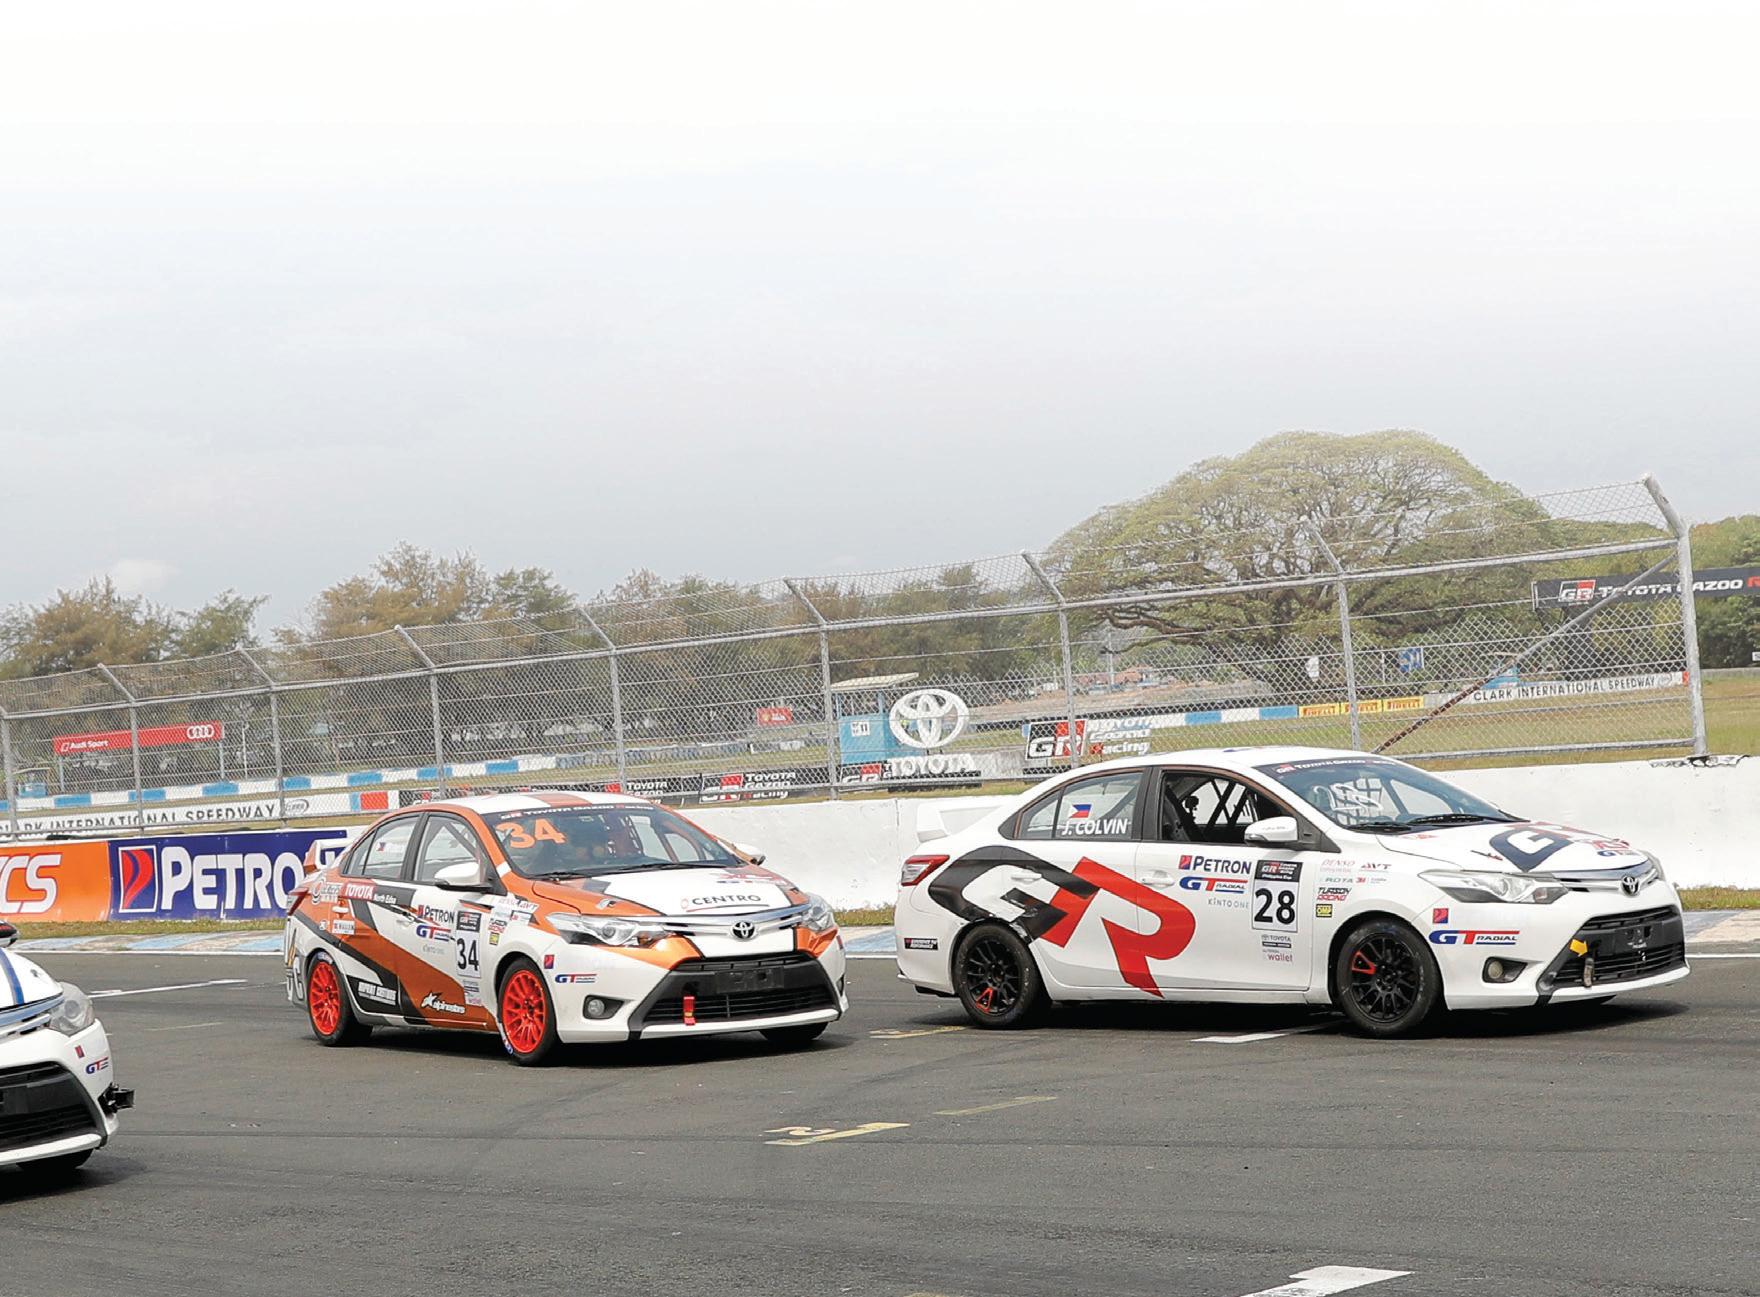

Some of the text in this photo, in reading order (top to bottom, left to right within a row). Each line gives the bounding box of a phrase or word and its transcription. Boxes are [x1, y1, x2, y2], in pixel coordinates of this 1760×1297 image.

[1474, 677, 1655, 701] CLARK INTERNATIONAL SPEEDWAY
[70, 741, 88, 750] Audi
[890, 753, 977, 777] TOYOTA
[745, 772, 796, 782] TOYOTA
[626, 781, 667, 790] TOYOTA
[526, 808, 572, 816] TOYOTA
[496, 818, 567, 849] 34
[1062, 818, 1128, 835] J. COLVIN
[1193, 856, 1252, 874] PETRON
[161, 845, 336, 911] PETRO
[1180, 876, 1226, 891] GT
[345, 883, 374, 900] TOYOTA
[692, 895, 761, 905] CENTRO
[1254, 888, 1296, 925] 28
[425, 905, 455, 924] PETRON
[417, 925, 442, 939] GT
[1429, 930, 1488, 945] GT
[457, 938, 479, 971] 34
[1268, 953, 1293, 962] wallet
[555, 974, 582, 983] GT
